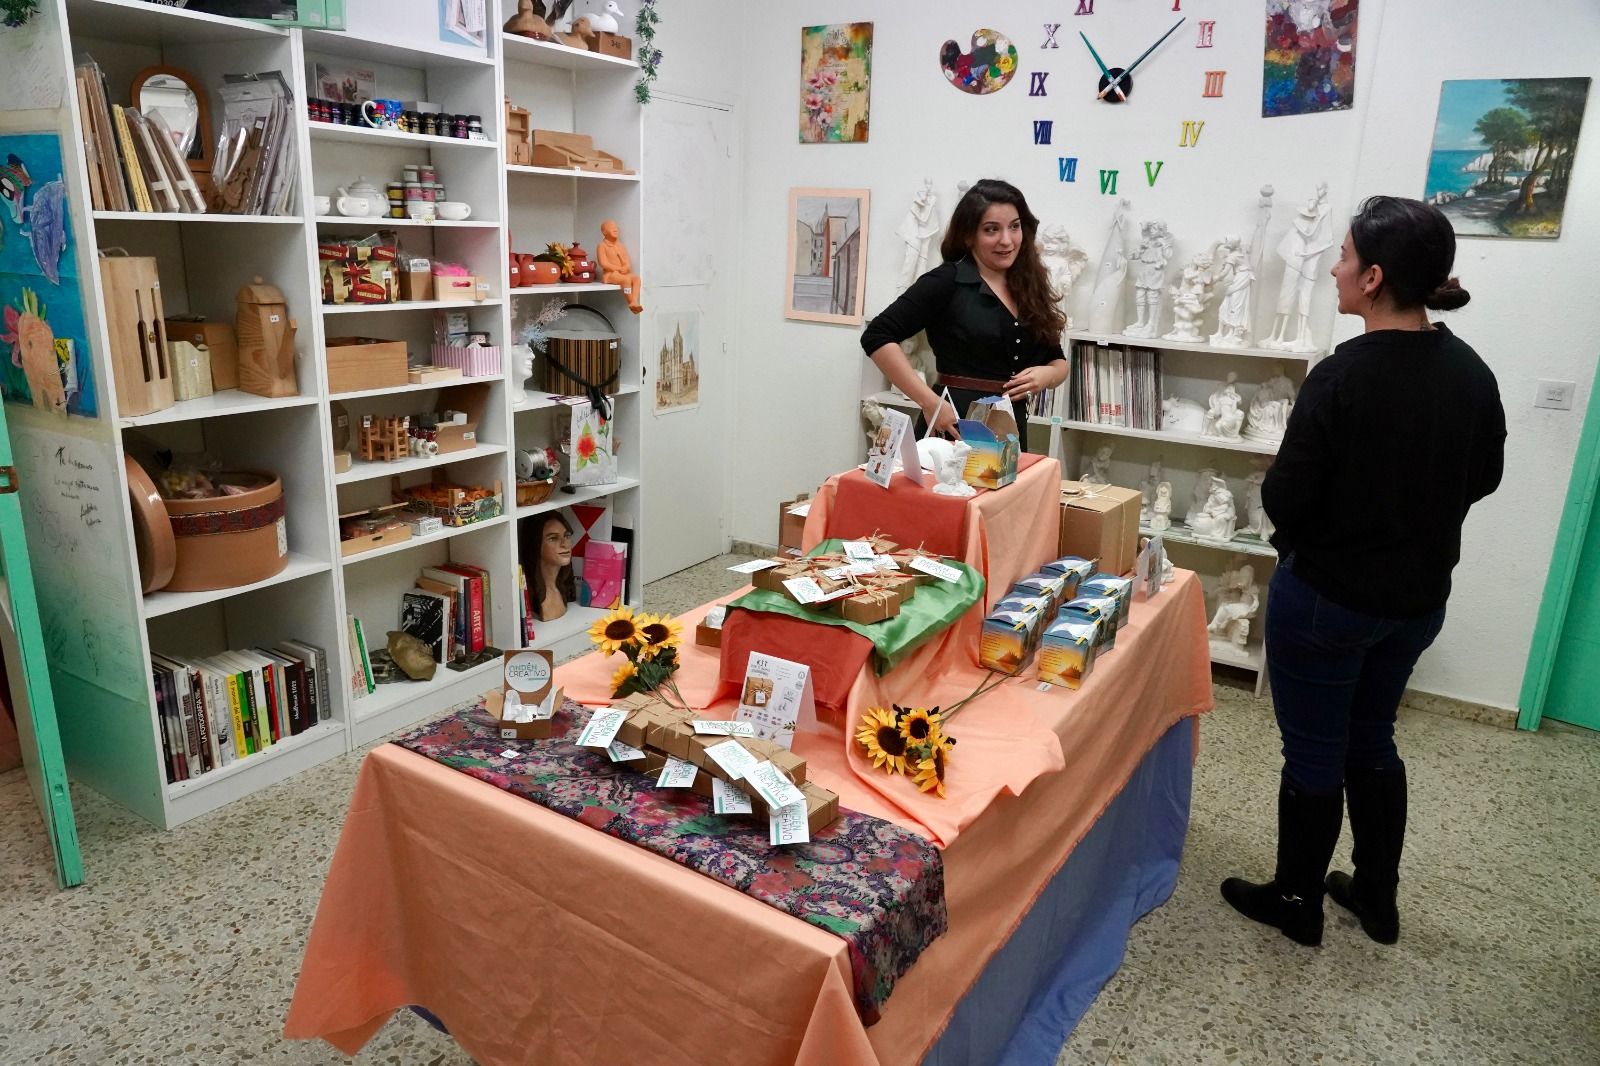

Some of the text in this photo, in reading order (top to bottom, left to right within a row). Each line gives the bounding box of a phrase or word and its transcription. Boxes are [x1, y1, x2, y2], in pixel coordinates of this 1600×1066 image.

[1040, 24, 1061, 49] X
[1196, 20, 1216, 48] II
[1029, 72, 1049, 97] IX
[1202, 71, 1227, 98] III
[1033, 120, 1053, 145] VIII
[1179, 120, 1205, 148] IV
[1058, 157, 1078, 182] VII
[1099, 169, 1119, 195] VI
[1144, 161, 1164, 187] V
[508, 669, 547, 678] CREATIVO
